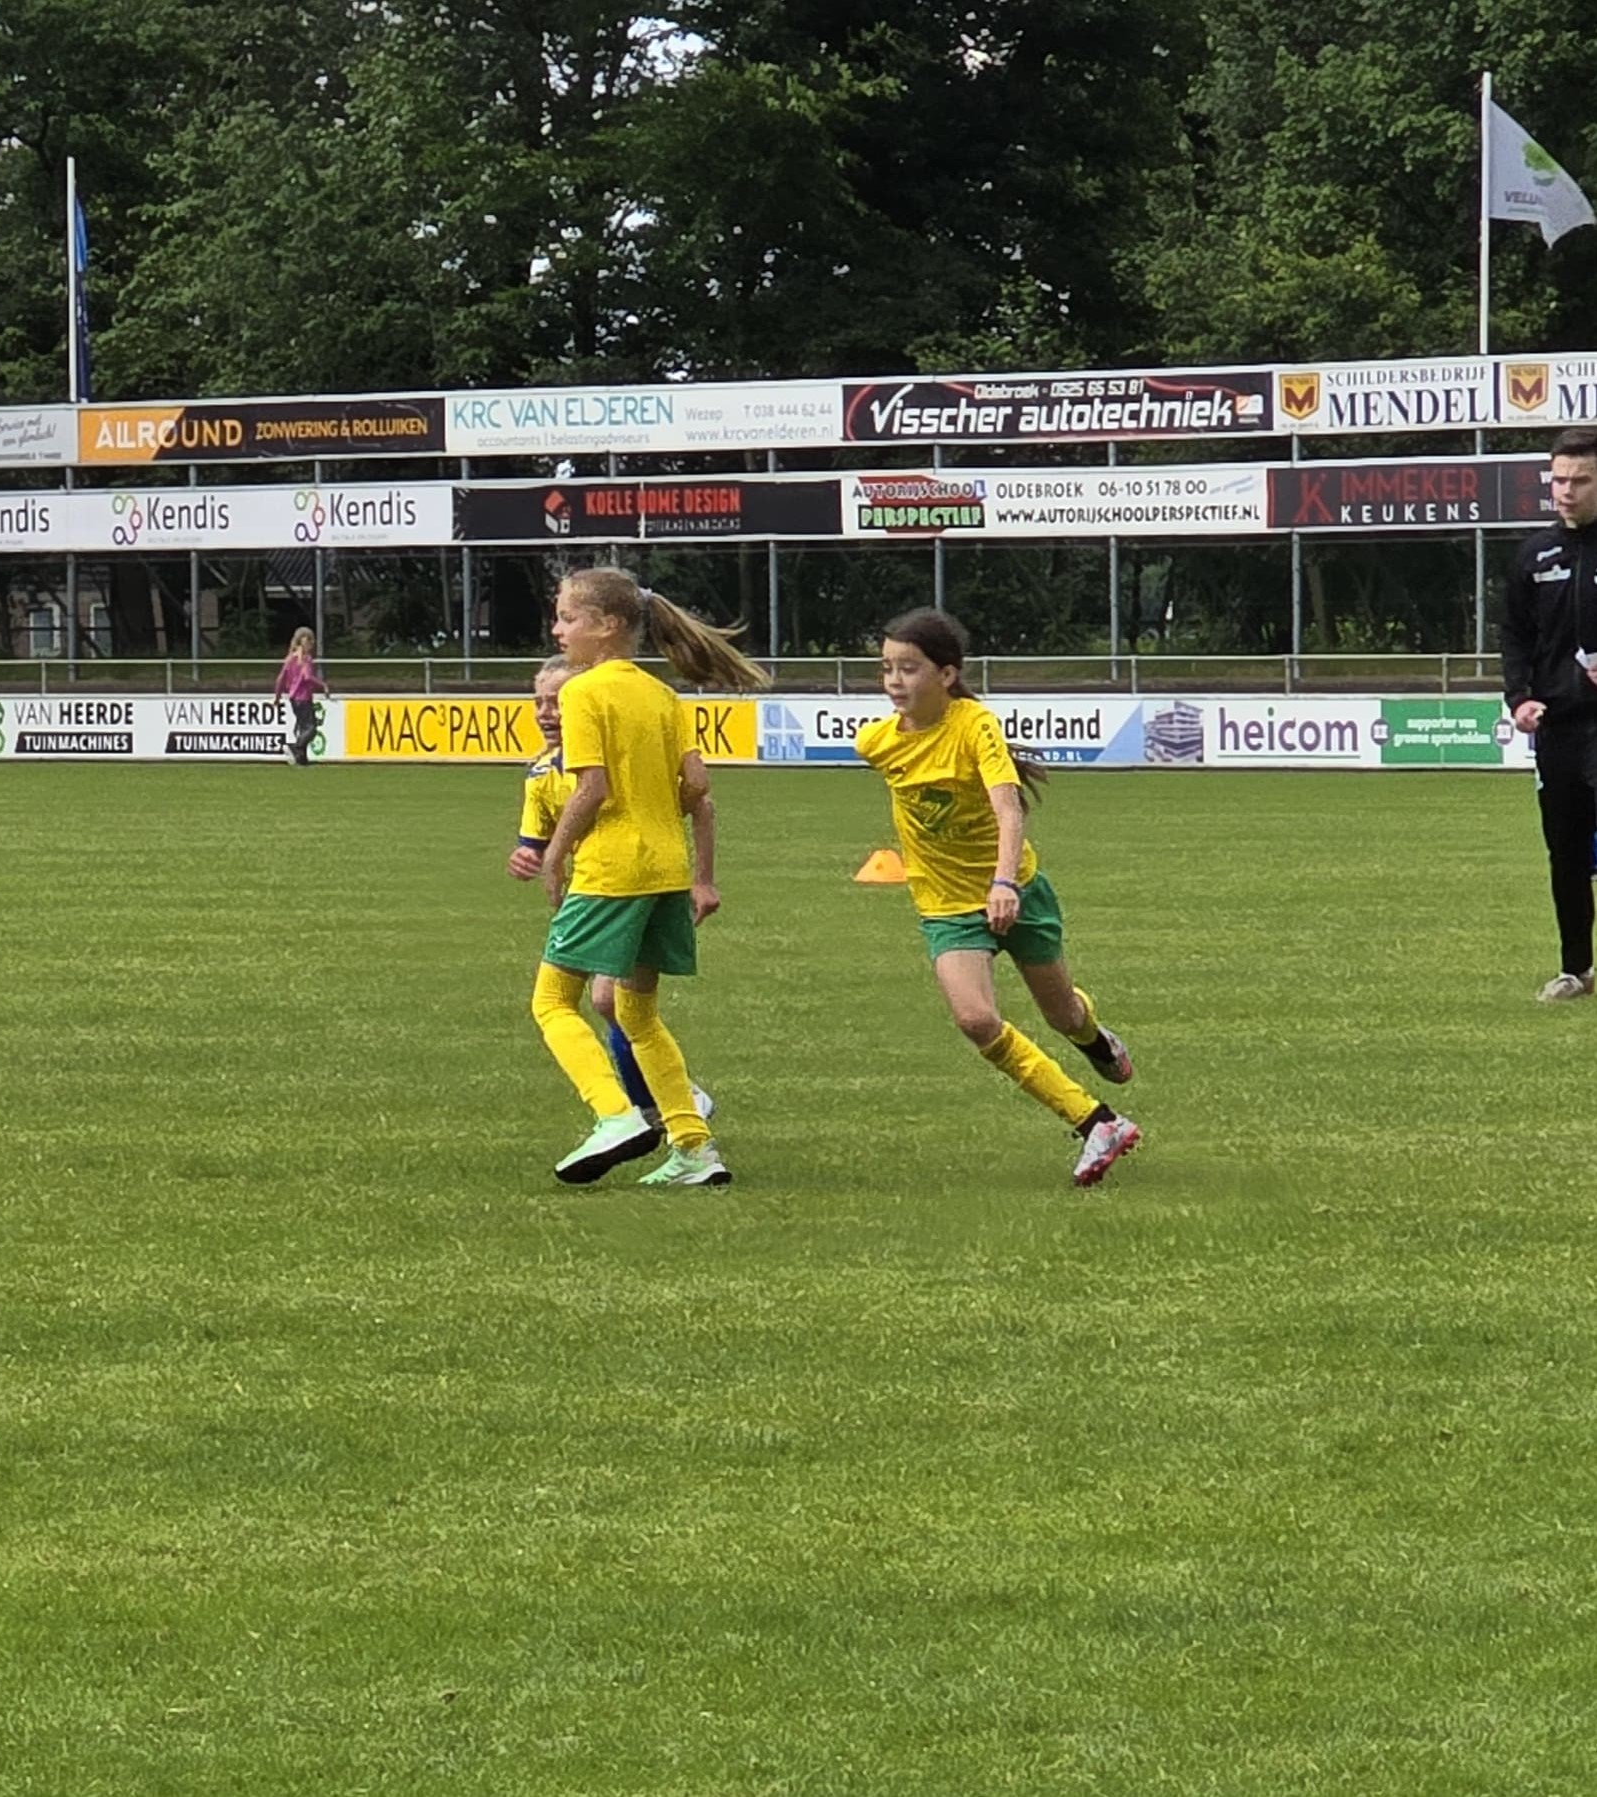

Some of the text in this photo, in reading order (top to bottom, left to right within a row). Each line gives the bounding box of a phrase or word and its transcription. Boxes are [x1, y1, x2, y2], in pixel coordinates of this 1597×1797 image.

[1327, 366, 1486, 388] SCHILDERSBEDRIJF
[973, 383, 1040, 400] Oldebroek
[453, 394, 674, 429] KRC VAN ELDEREN
[684, 407, 723, 422] Wezep
[744, 405, 751, 418] T
[753, 404, 774, 418] 038
[778, 403, 798, 417] 444
[818, 402, 832, 416] 44
[870, 382, 1233, 435] Visscher autotechniek
[1328, 387, 1489, 427] MENDEL
[95, 417, 428, 449] ALLROUND ZONWERING & ROLLUIKEN
[477, 434, 540, 448] accountants
[684, 423, 834, 441] www.krcvanelderen.nl
[853, 479, 988, 500] AUTORIJSCHOOL
[996, 482, 1084, 500] OLDEBROEK
[1098, 481, 1142, 498] 06-10
[1164, 480, 1182, 497] 78
[1185, 479, 1208, 496] 00
[330, 491, 417, 527] Kendis
[585, 490, 633, 515] KOELE
[684, 487, 741, 514] DESIGN
[147, 495, 230, 531] Kendis
[859, 505, 983, 528] PERSPECTIEF
[996, 504, 1261, 526] WWW.AUTORIJSCHOOLPERSPECTIEF.NL
[1340, 502, 1480, 523] KEUKENS
[14, 701, 133, 726] VAN HEERDE
[165, 701, 286, 726] VAN HEERDE
[1218, 706, 1359, 753] heicom
[24, 735, 129, 753] TUINMACHINES
[174, 735, 282, 753] TUINMACHINES
